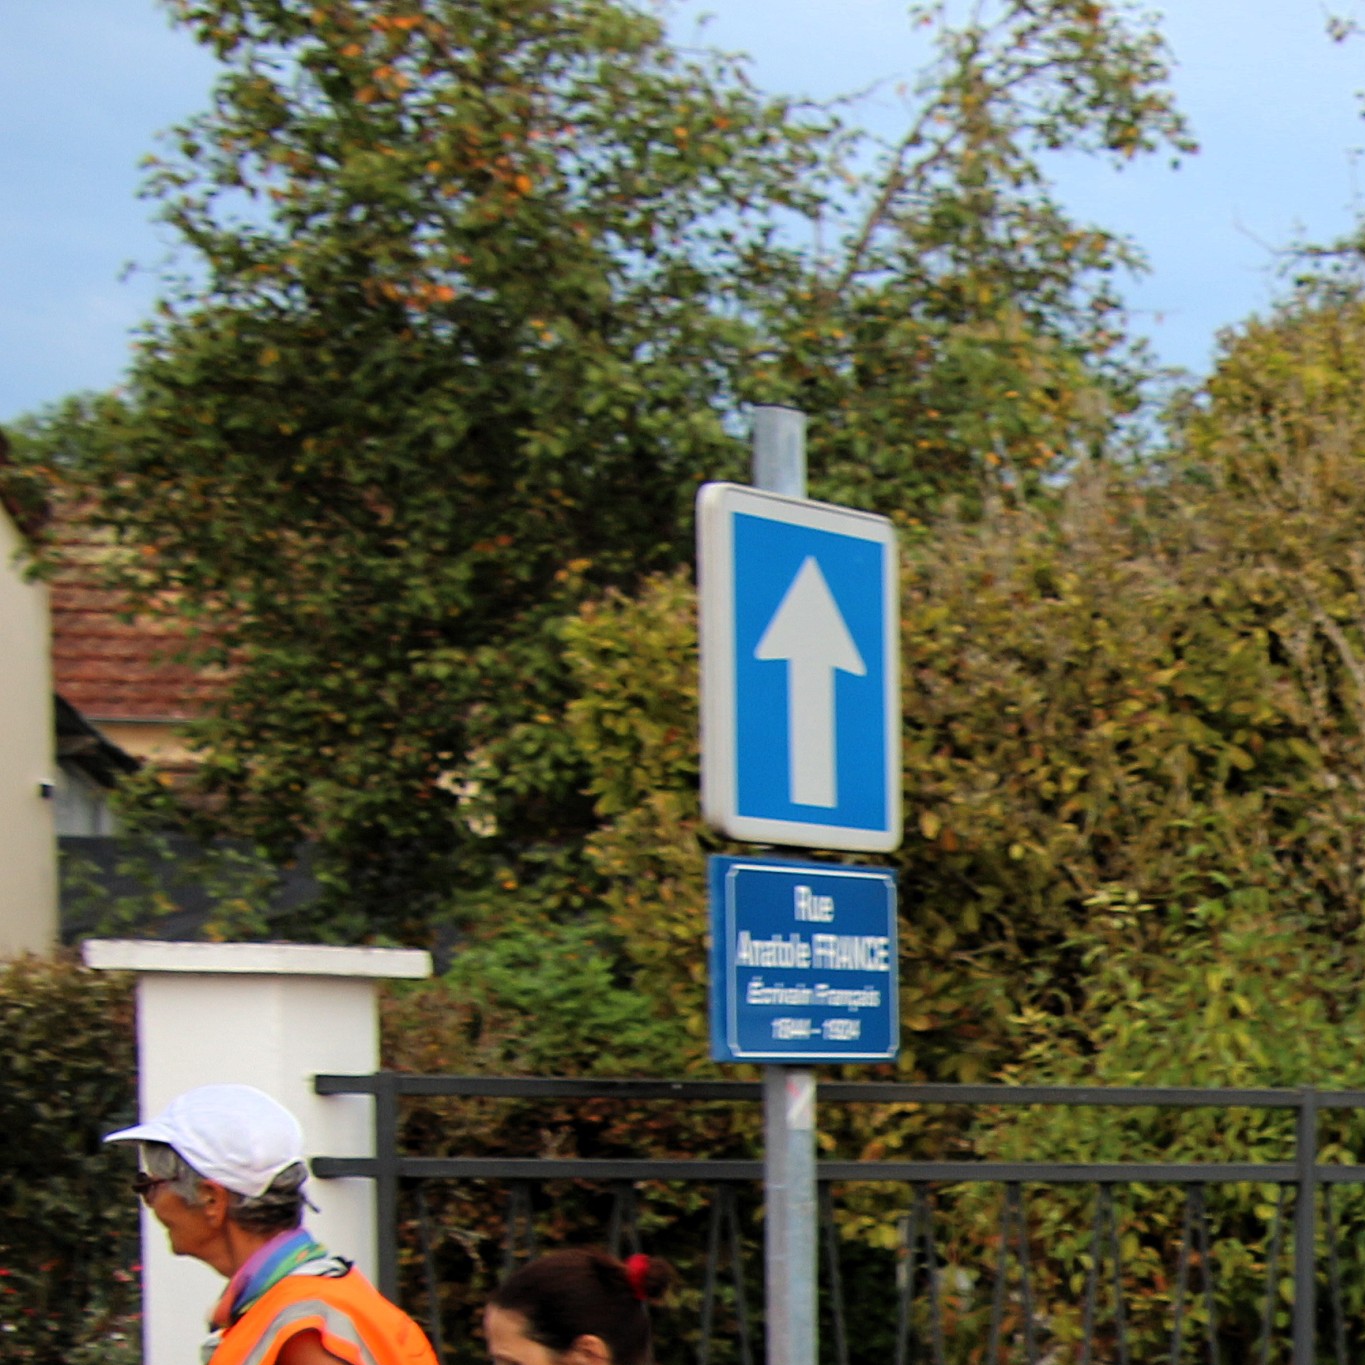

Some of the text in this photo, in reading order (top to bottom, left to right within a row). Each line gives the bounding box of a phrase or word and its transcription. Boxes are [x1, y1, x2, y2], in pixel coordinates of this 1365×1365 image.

[794, 885, 835, 922] Rue
[736, 931, 890, 971] Anatole FRANCE
